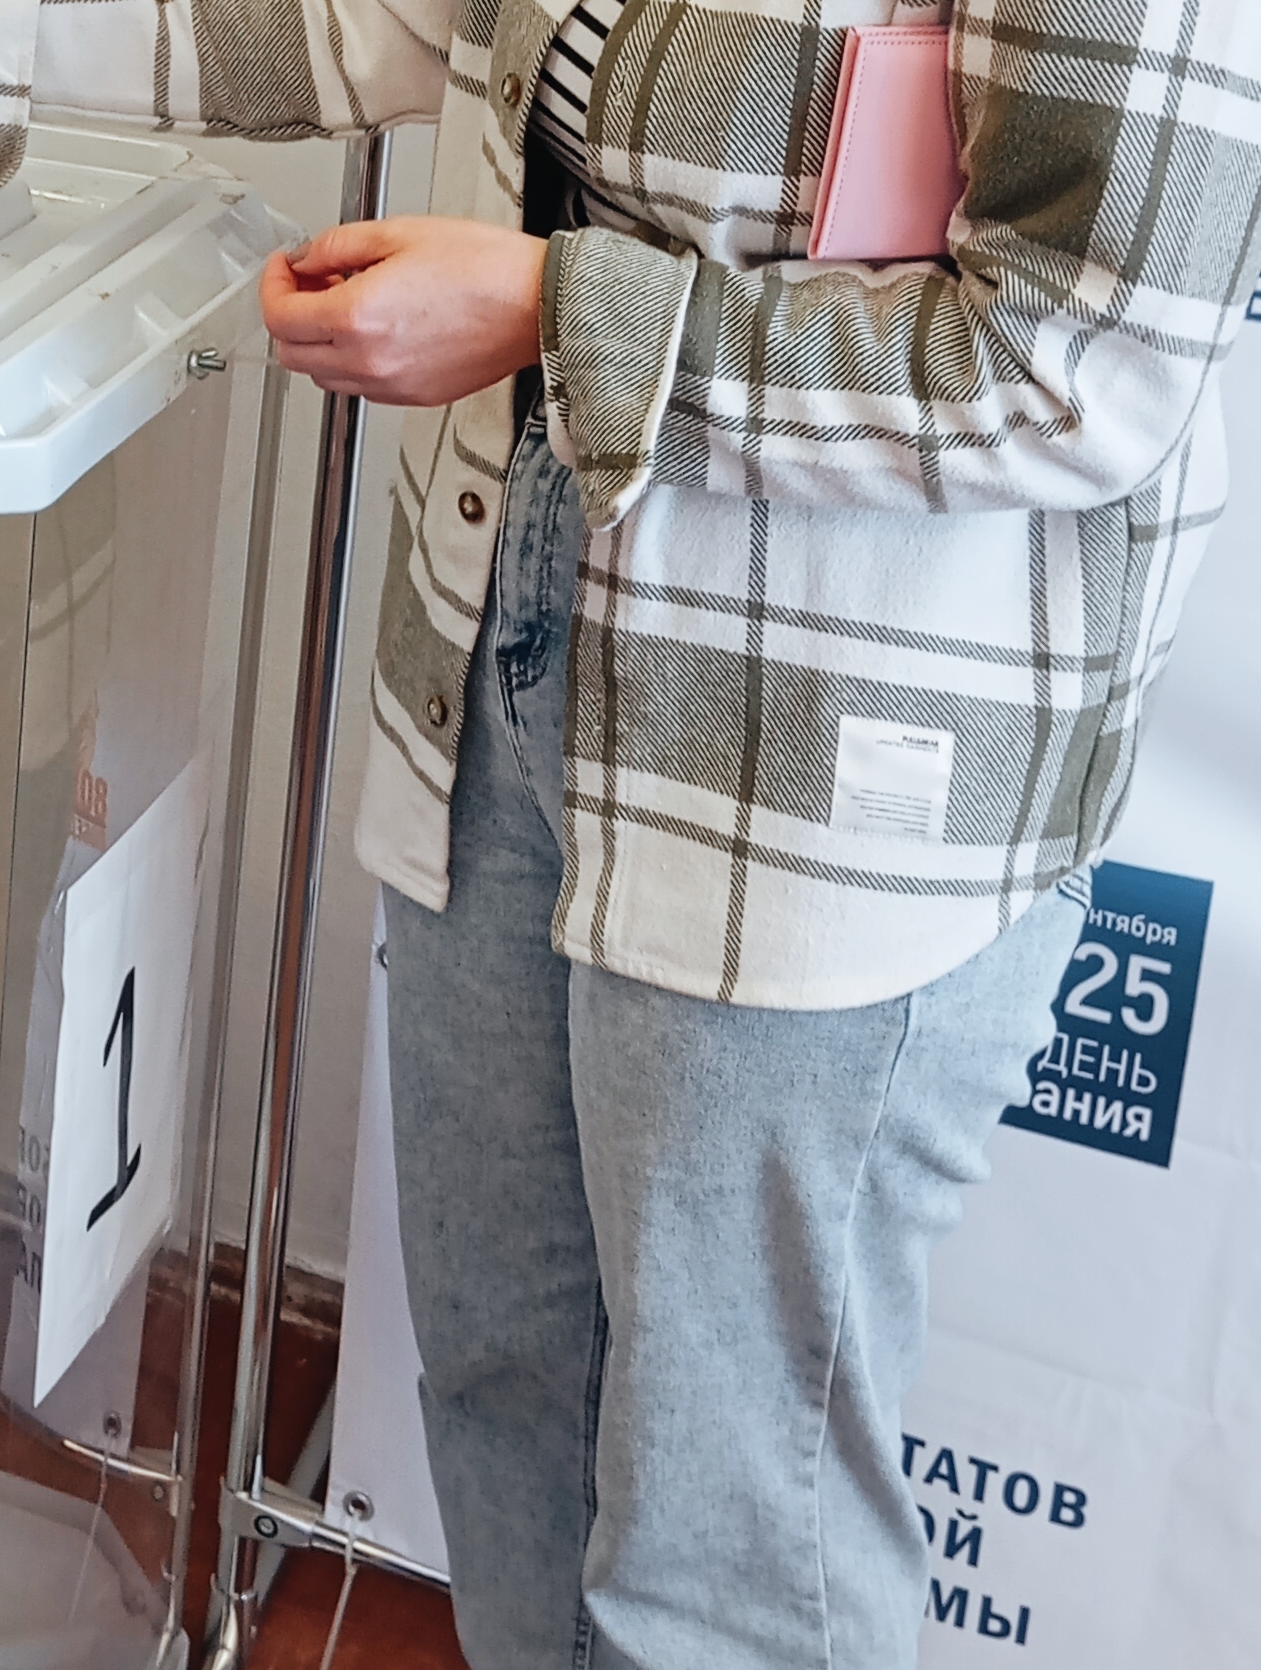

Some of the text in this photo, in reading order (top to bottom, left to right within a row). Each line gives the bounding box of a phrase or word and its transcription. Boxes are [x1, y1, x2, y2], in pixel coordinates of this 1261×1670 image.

[1063, 941, 1172, 1036] 25
[86, 965, 142, 1232] 1
[1037, 1031, 1158, 1095] ДЕНЬ
[1031, 1080, 1153, 1142] ания
[901, 1431, 1088, 1529] ТАТОВ
[924, 1576, 1032, 1647] МЫ
